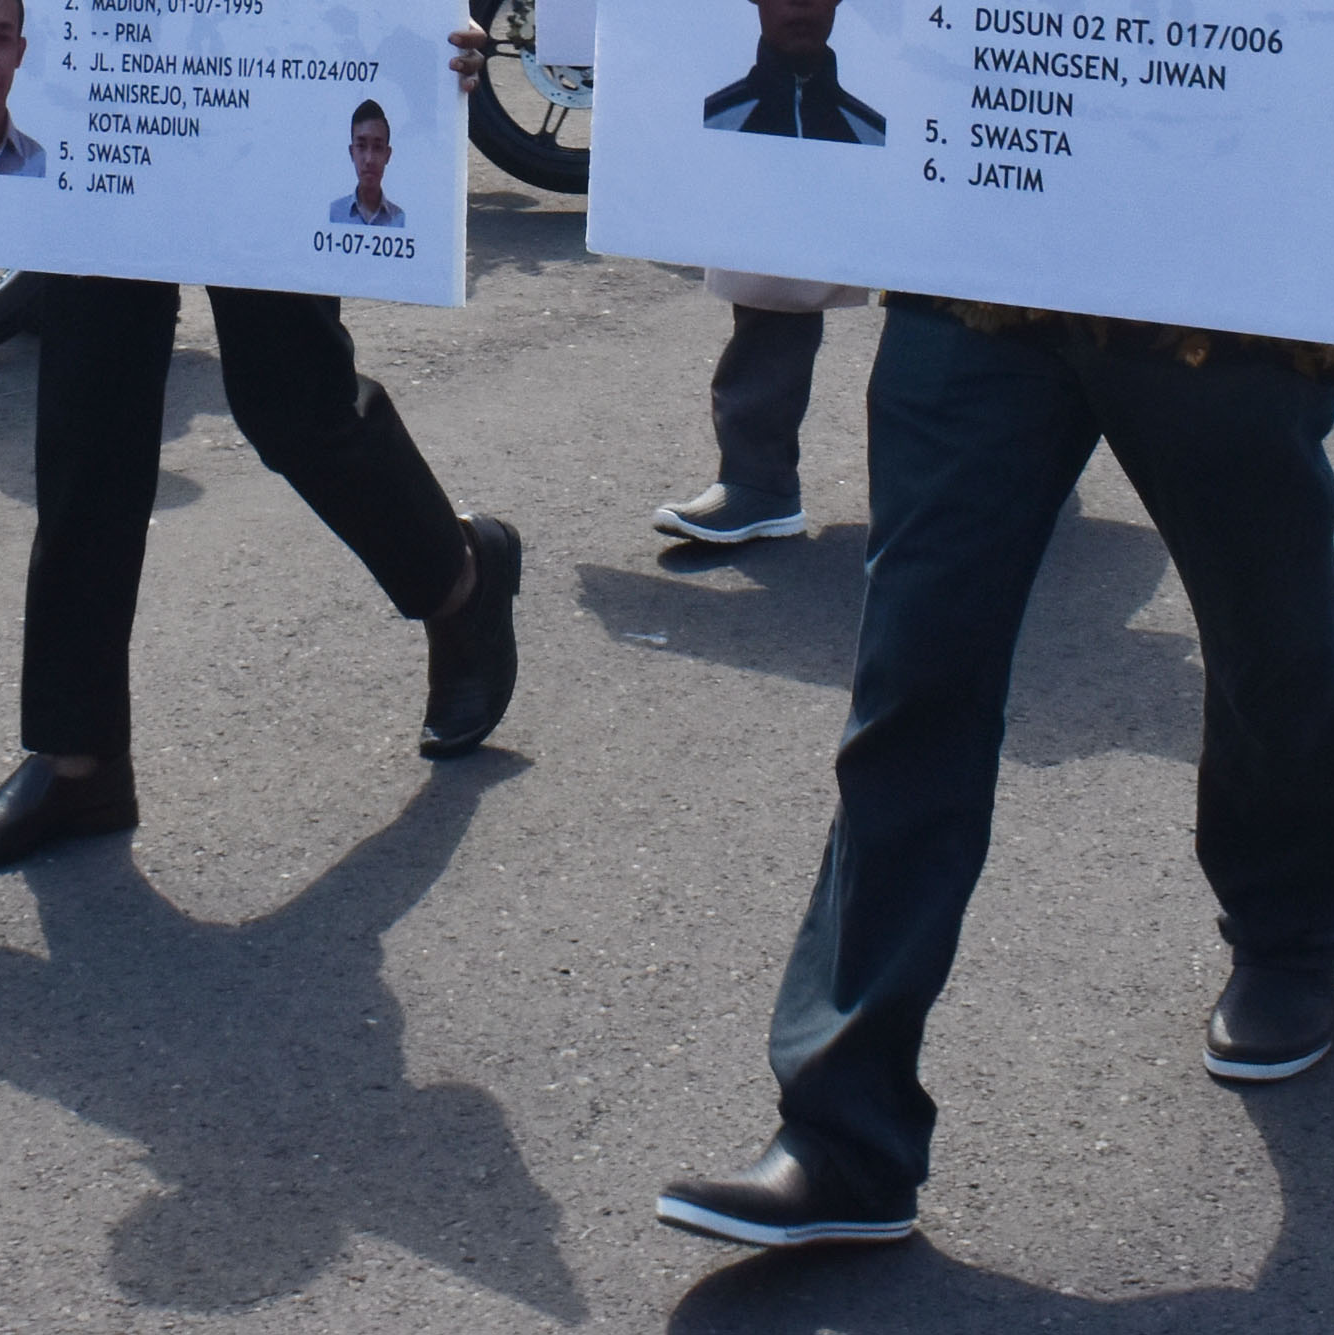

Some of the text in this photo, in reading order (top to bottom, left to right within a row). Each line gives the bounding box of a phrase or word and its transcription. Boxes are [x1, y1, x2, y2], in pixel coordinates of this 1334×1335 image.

[115, 23, 152, 43] PRIA
[975, 8, 1284, 54] DUSUN 02 RT. 017/006
[90, 53, 378, 82] JL. ENDAH MANIS II/14 RT.024/007
[974, 47, 1226, 91] KWANGSEN, JIWAN
[89, 85, 249, 108] MANISREJO, TAMAN
[971, 86, 1073, 116] MADIUN
[88, 115, 199, 137] KOTA MADIUN
[970, 124, 1072, 156] SWASTA
[87, 144, 151, 166] SWASTA
[87, 173, 134, 195] JATIM
[969, 163, 1043, 192] JATIM
[314, 232, 415, 258] 01-07-2025
